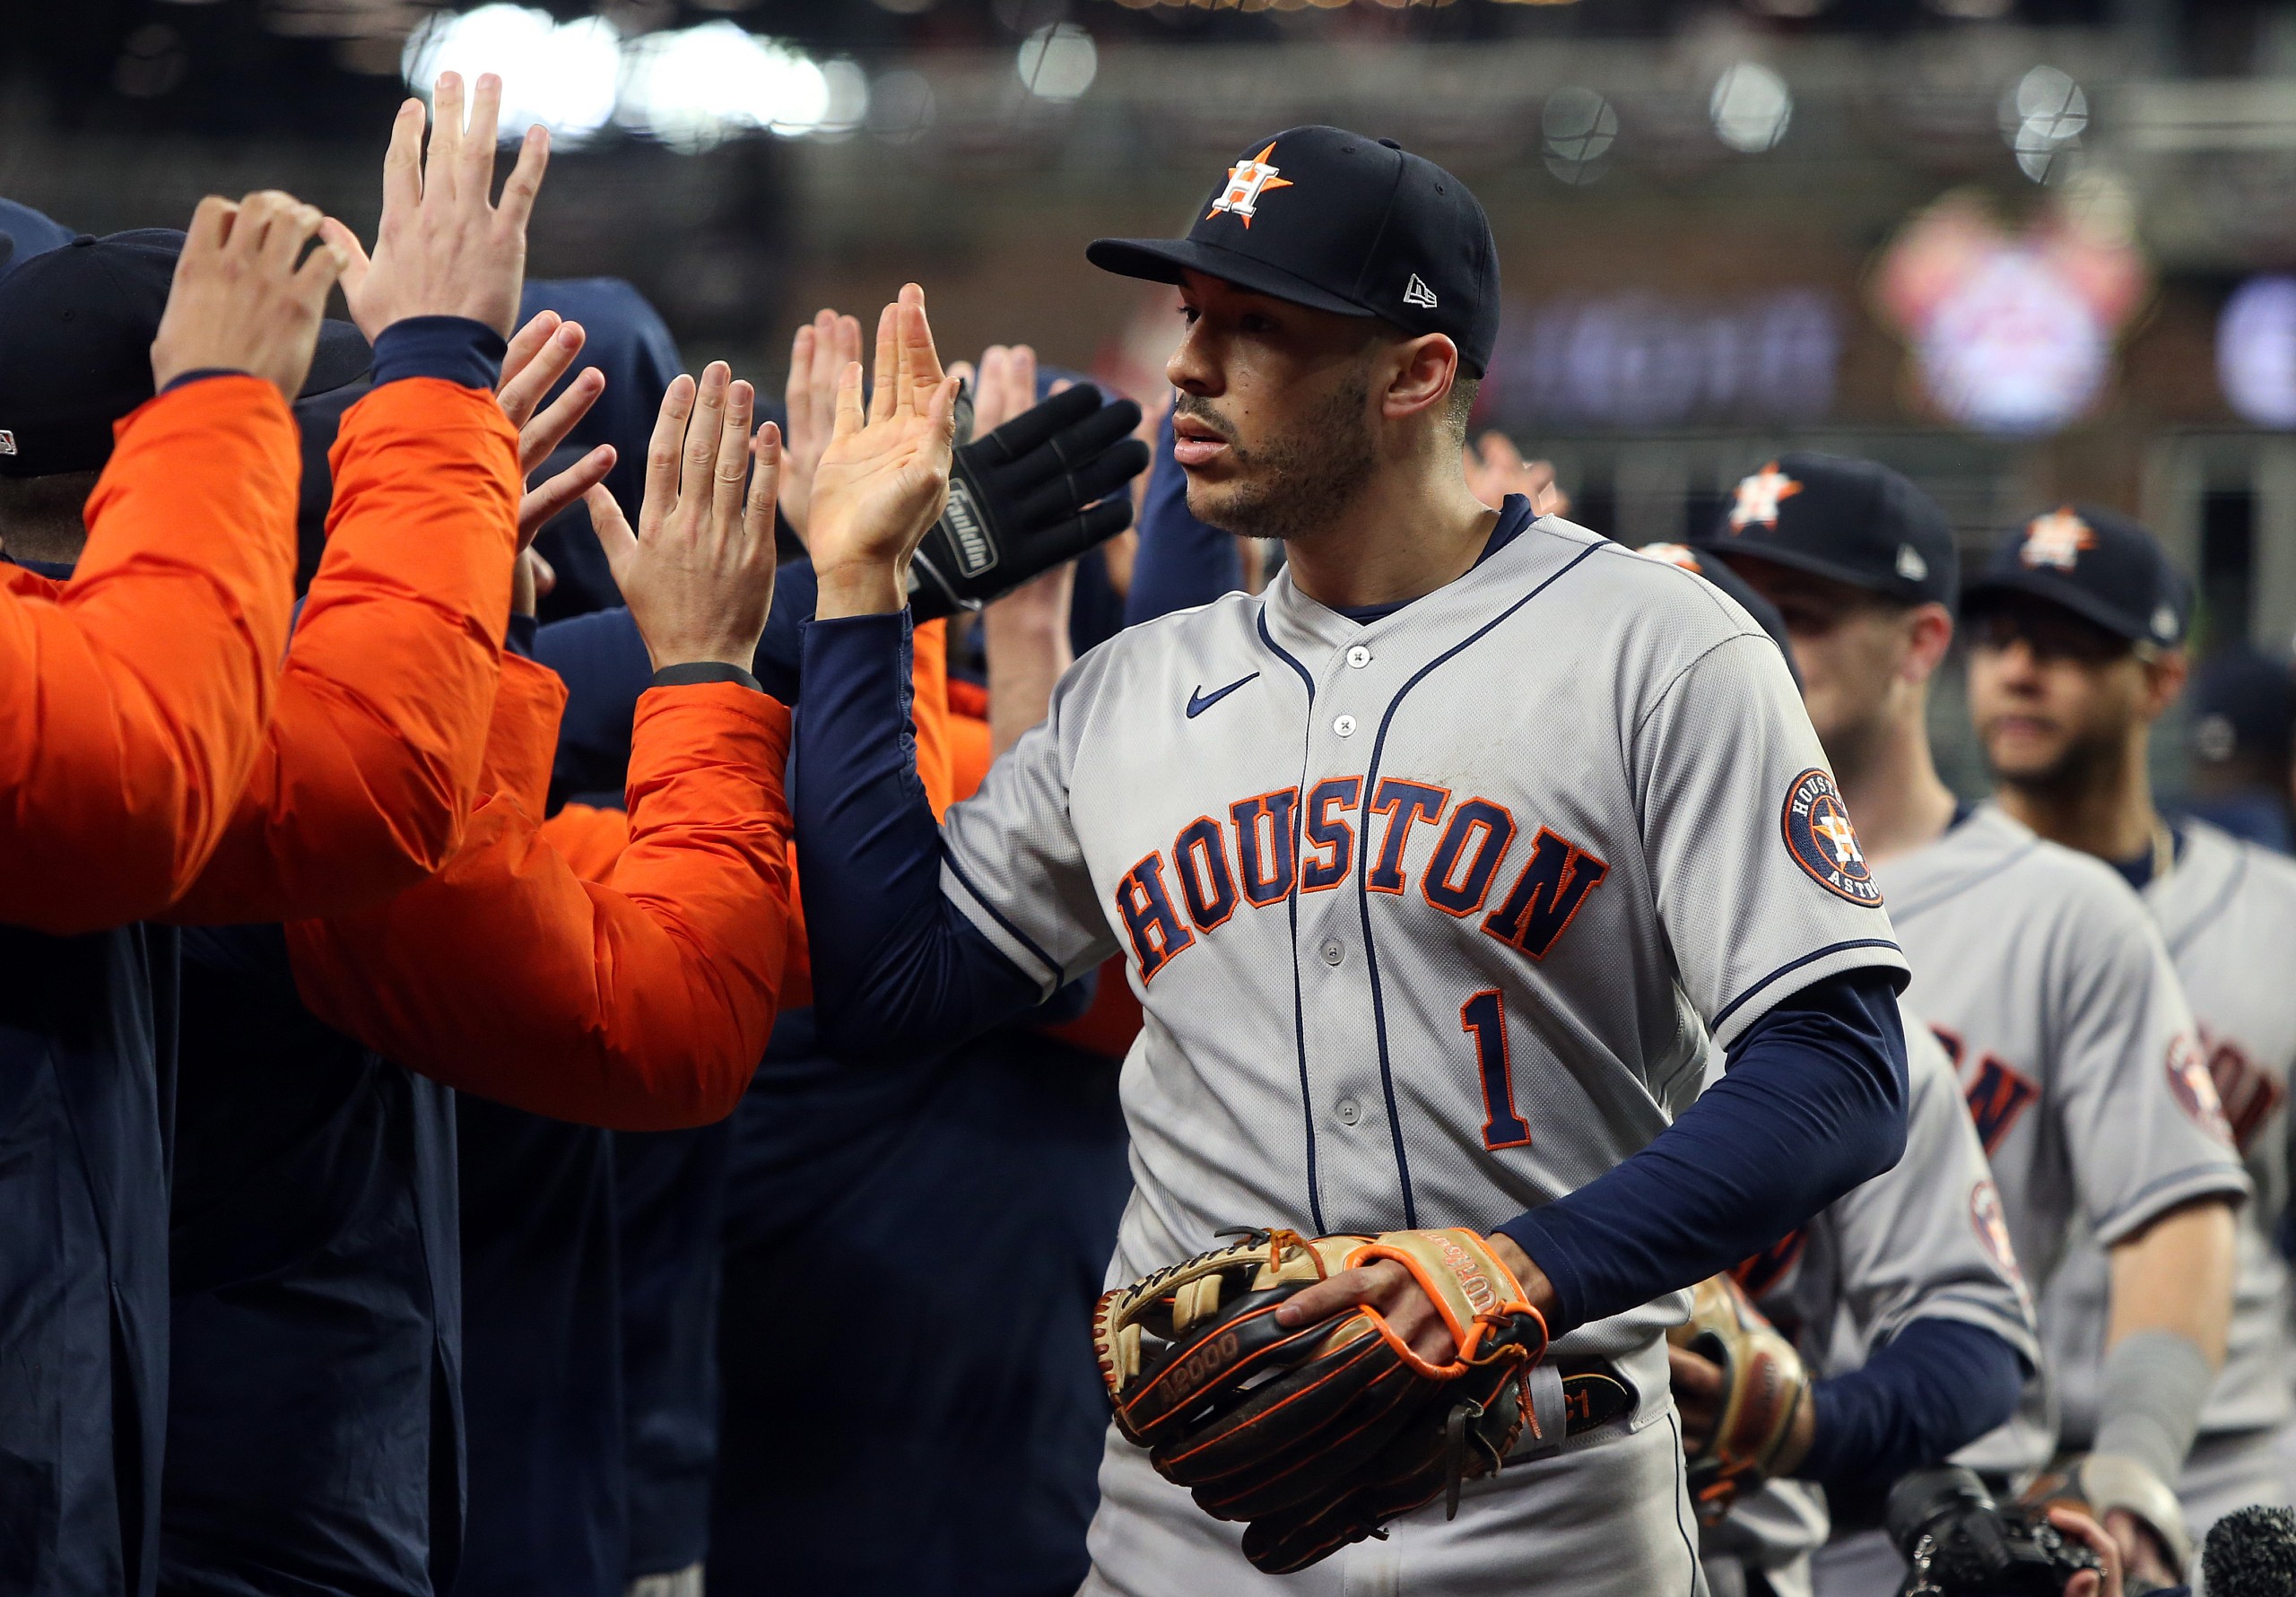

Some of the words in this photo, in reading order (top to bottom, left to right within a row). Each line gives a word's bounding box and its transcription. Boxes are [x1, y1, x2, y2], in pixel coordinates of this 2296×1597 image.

[1212, 160, 1280, 218] H
[1115, 775, 1610, 986] HOUSTON
[1460, 988, 1532, 1151] 1
